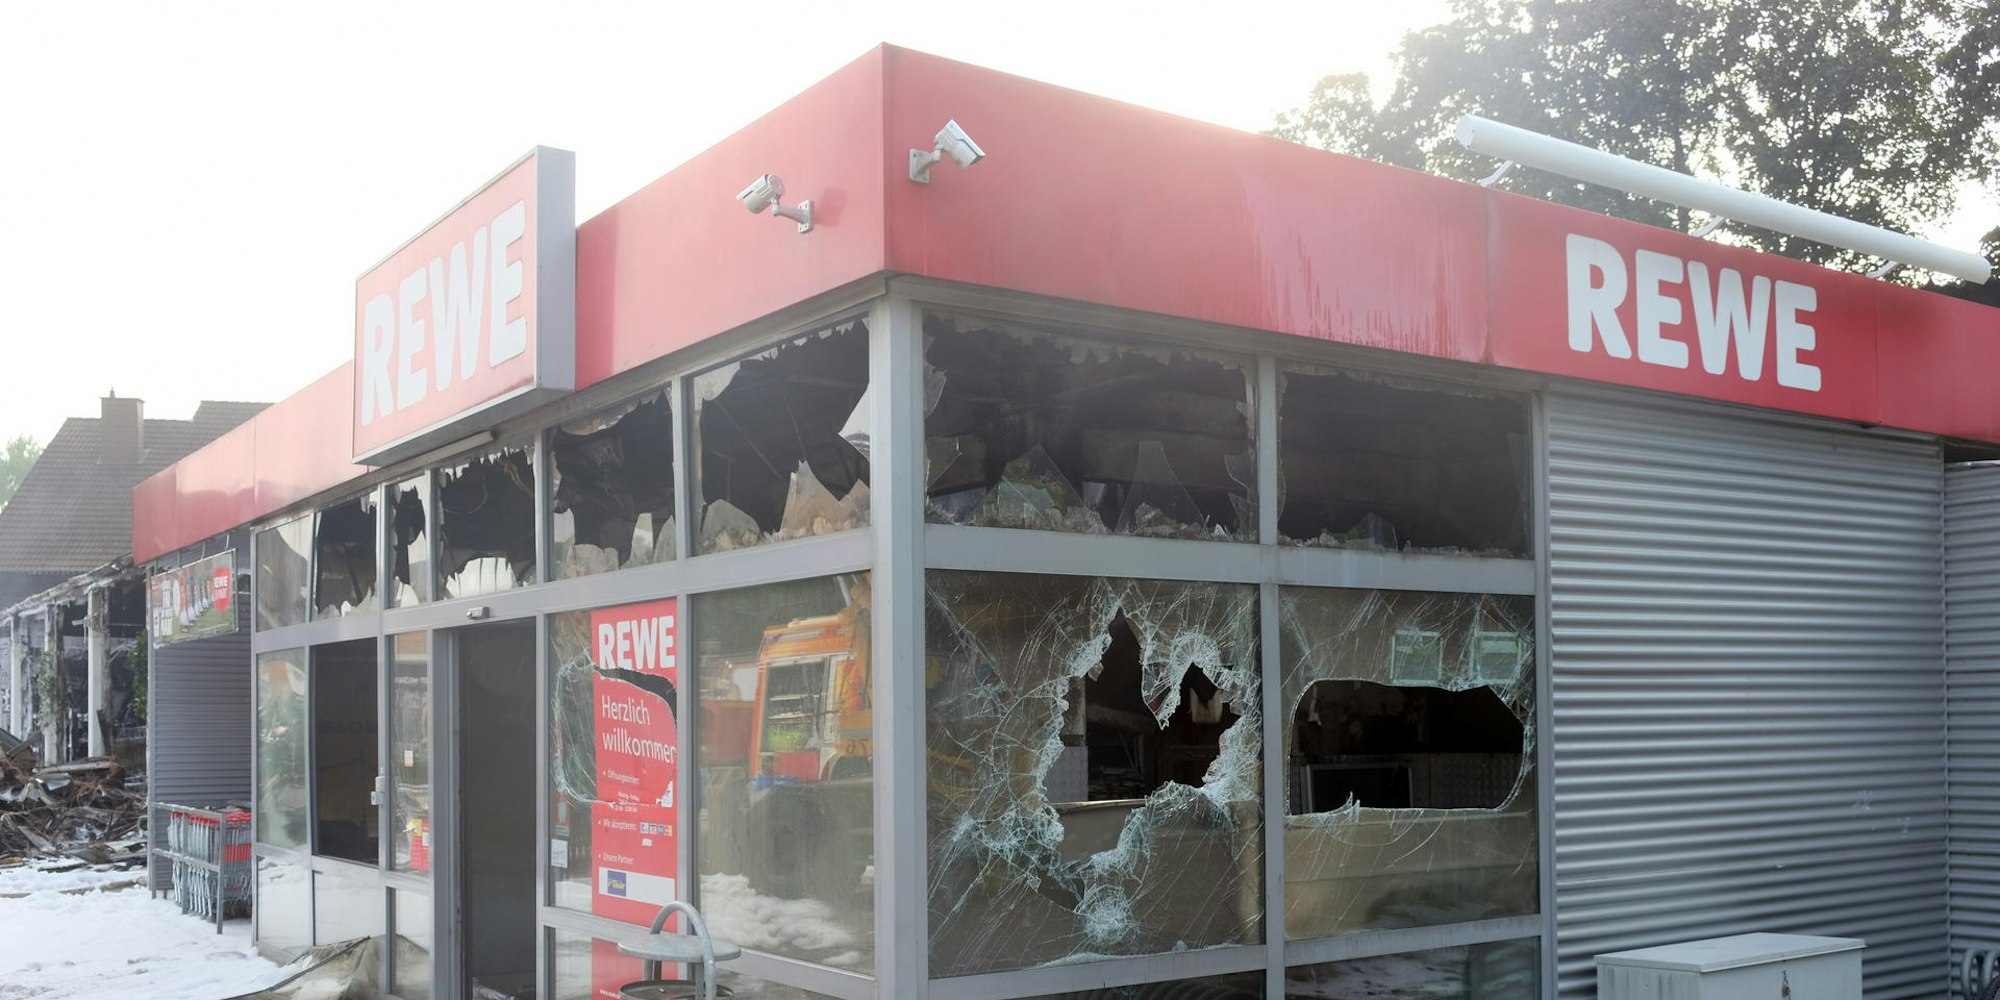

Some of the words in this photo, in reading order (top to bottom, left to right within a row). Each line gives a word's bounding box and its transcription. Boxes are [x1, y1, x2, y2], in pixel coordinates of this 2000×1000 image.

[362, 199, 527, 426] REWE
[1566, 233, 1821, 392] REWE
[598, 615, 675, 671] REWE
[602, 694, 650, 726] Herzlich
